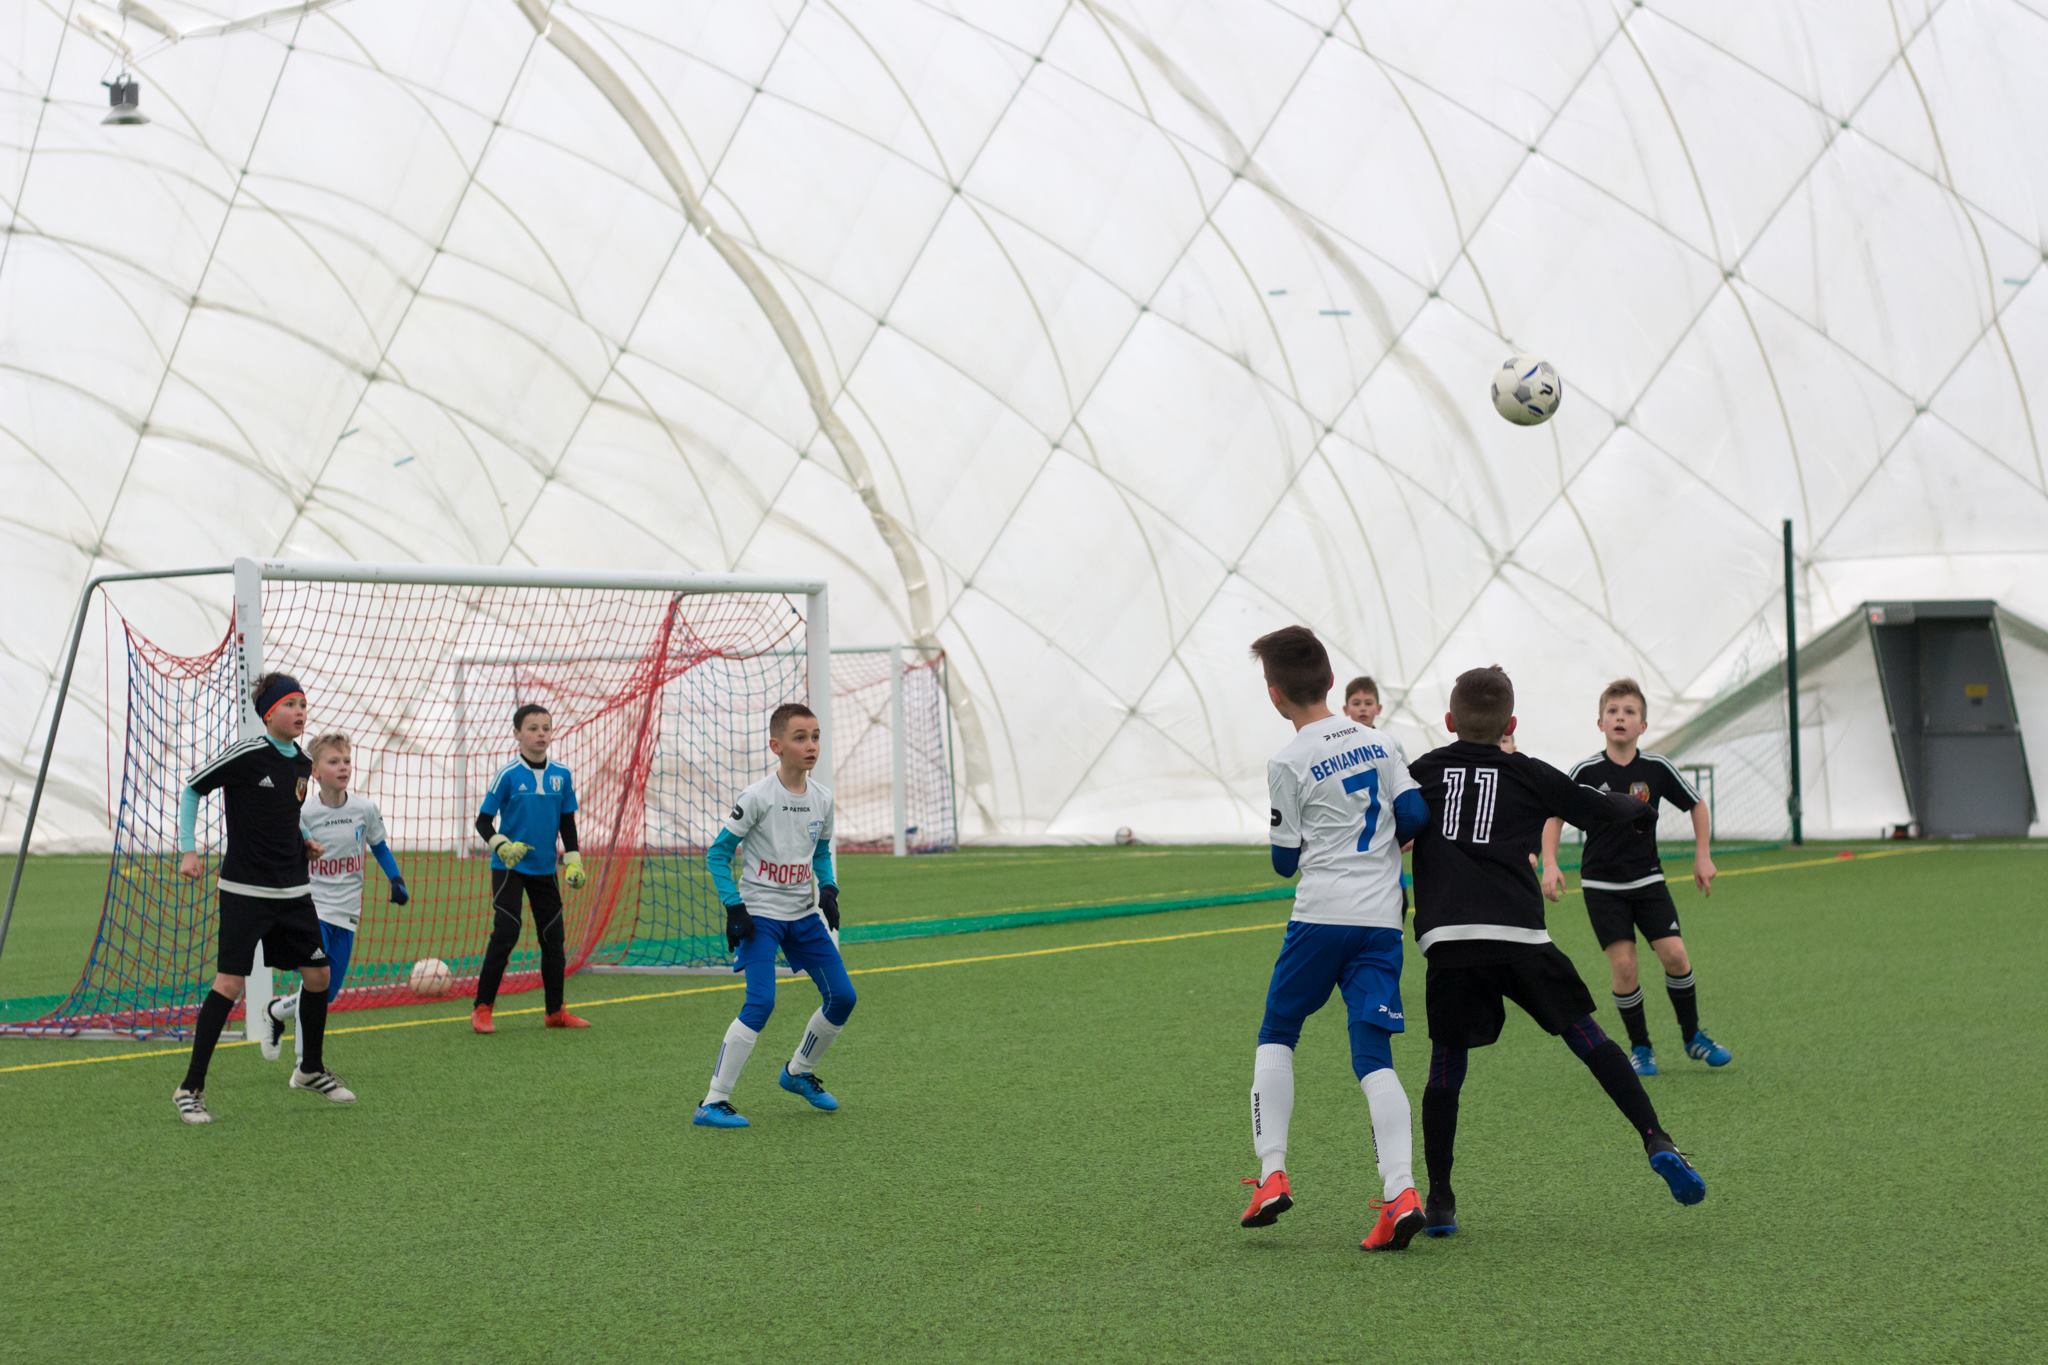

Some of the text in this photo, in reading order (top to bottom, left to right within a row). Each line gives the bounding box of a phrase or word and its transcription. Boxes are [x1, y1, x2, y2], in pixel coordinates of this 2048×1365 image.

[1331, 727, 1358, 739] PATRICK
[1341, 767, 1382, 852] 7
[1442, 767, 1499, 844] 11
